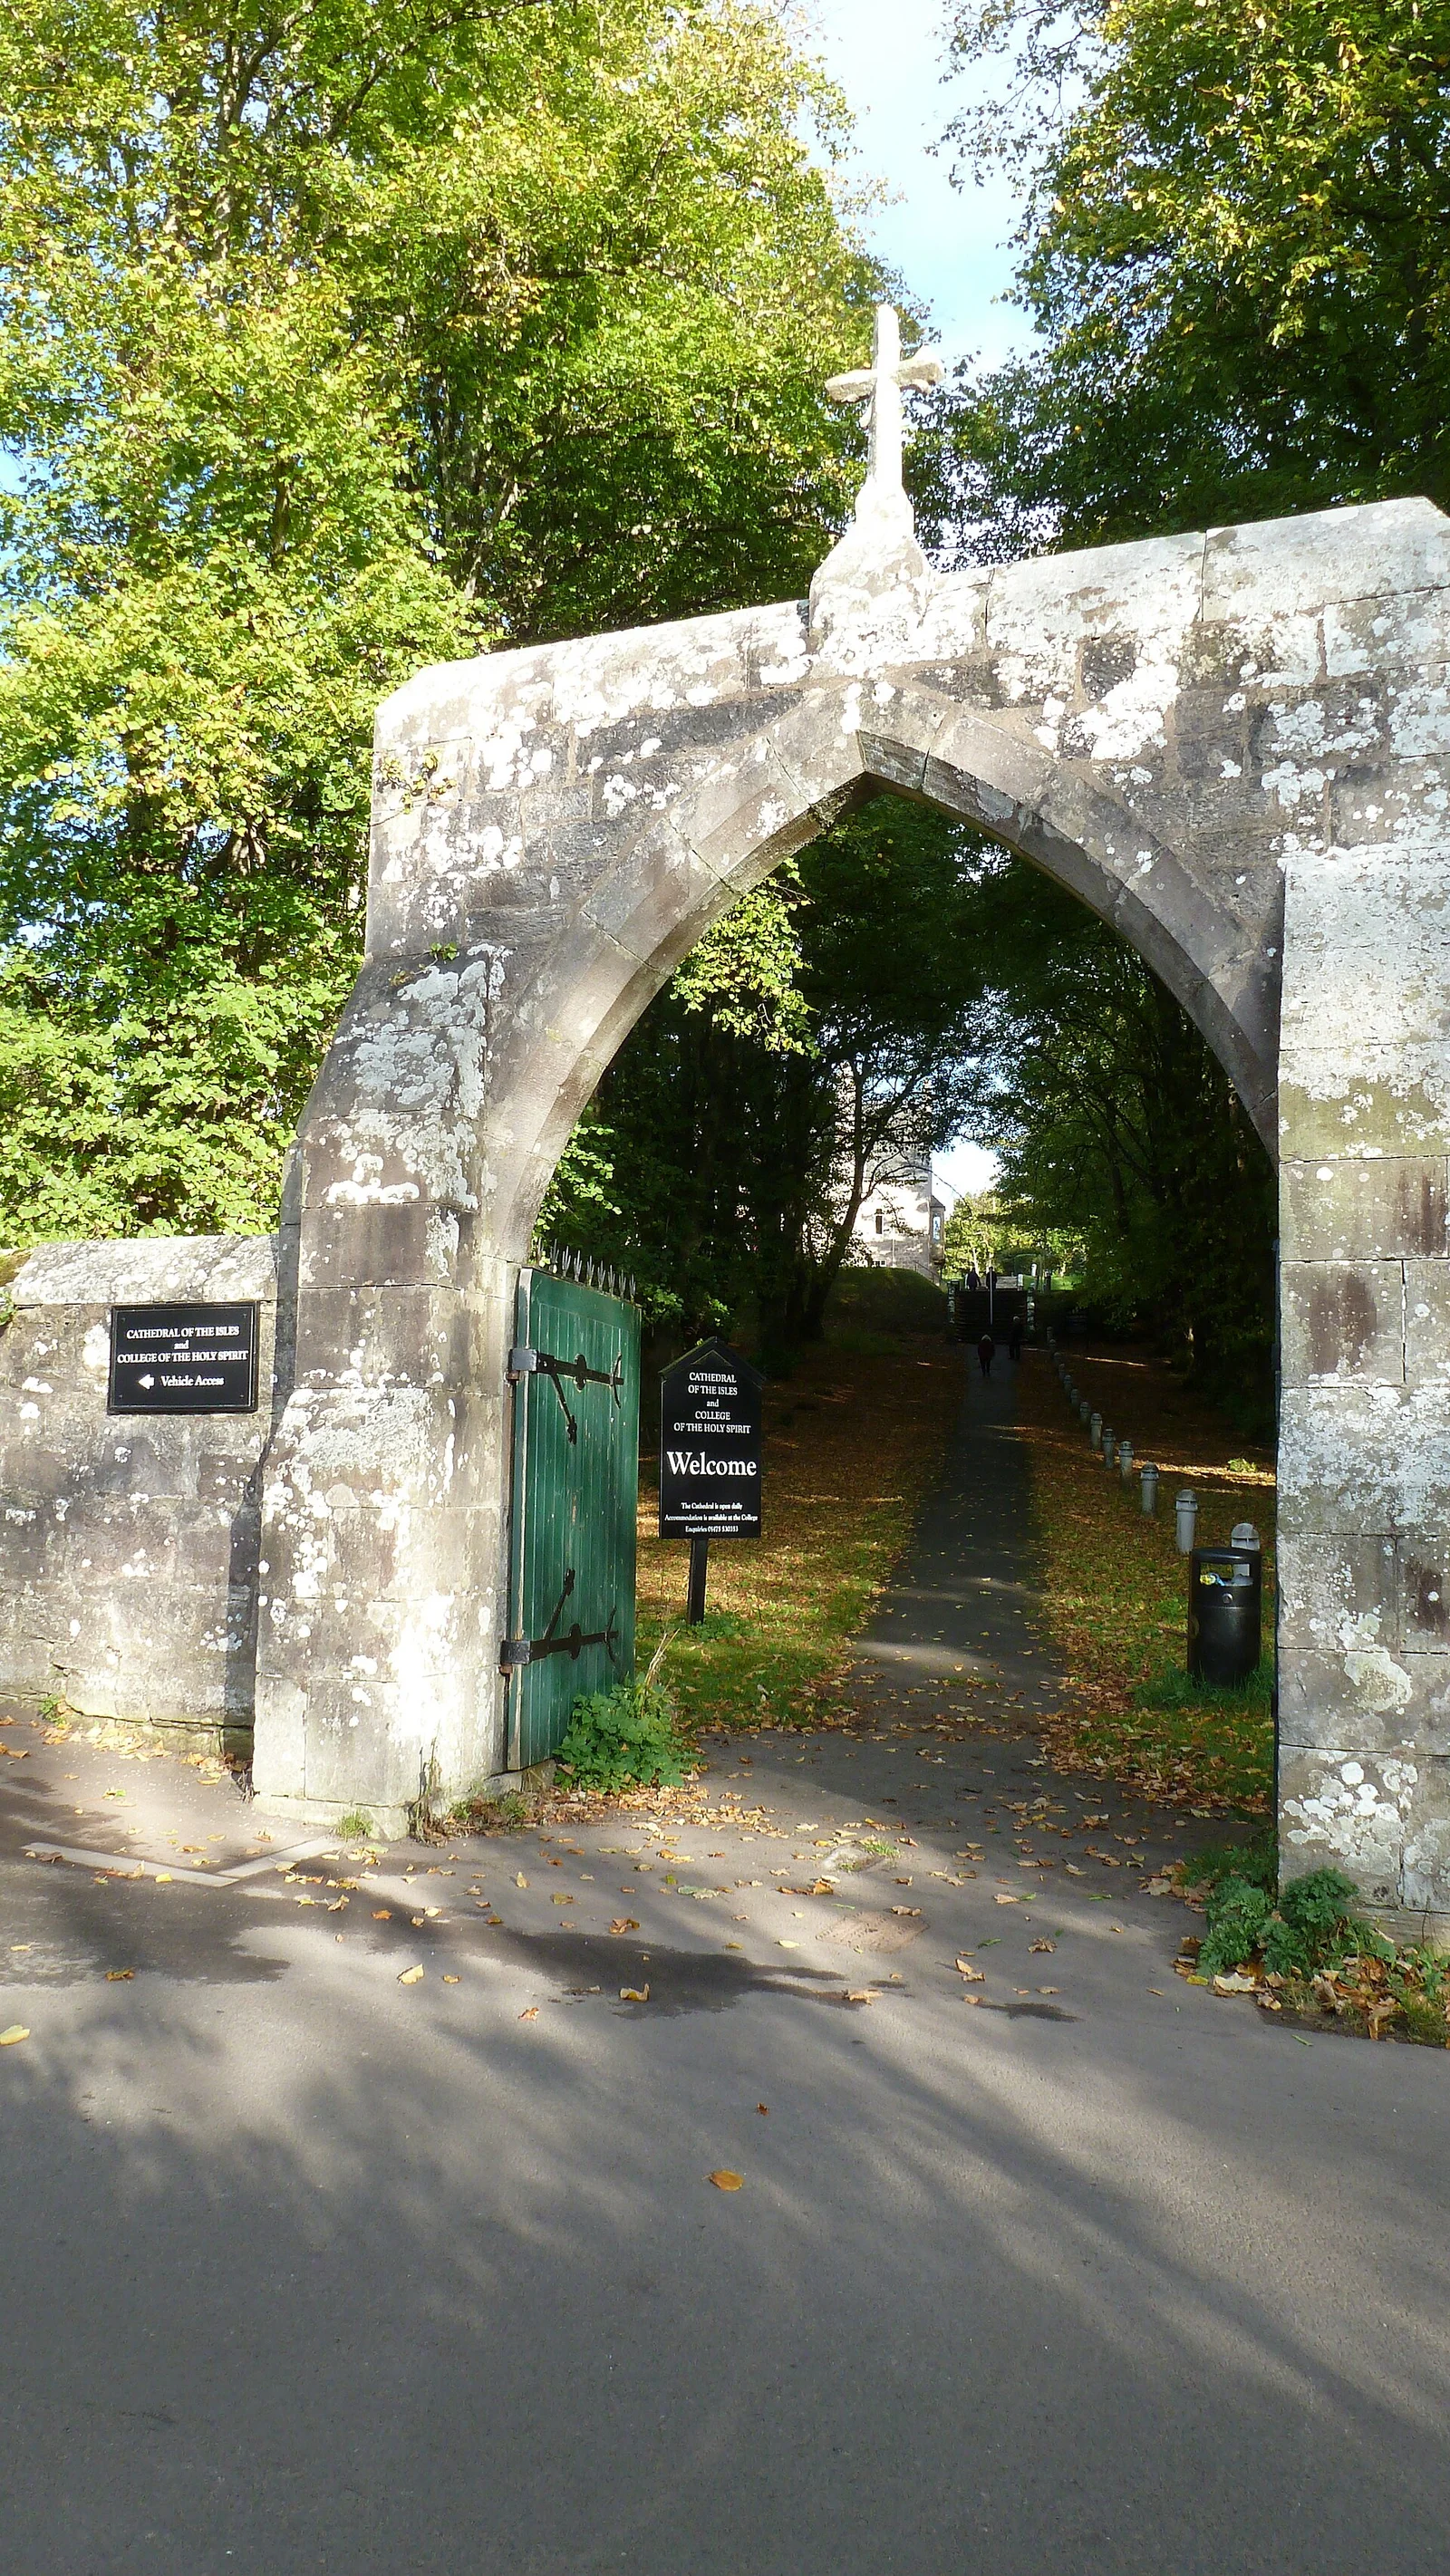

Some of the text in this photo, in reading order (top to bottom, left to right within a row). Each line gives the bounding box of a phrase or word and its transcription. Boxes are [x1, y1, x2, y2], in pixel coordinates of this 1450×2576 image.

[127, 1326, 239, 1339] CATHEDRAL OF THE ISLES
[174, 1340, 189, 1349] and
[117, 1350, 248, 1364] COLLEGE OF THE HOLY SPIRIT
[160, 1375, 224, 1386] Vehicle Access
[689, 1372, 737, 1383] CATHEDRAL
[688, 1385, 738, 1395] OF THE ISLES
[707, 1399, 719, 1407] and
[695, 1411, 730, 1420] COLLEGE
[673, 1423, 751, 1433] OF THE HOLY SPIRIT
[666, 1451, 757, 1476] Welcome
[731, 1502, 742, 1510] daily
